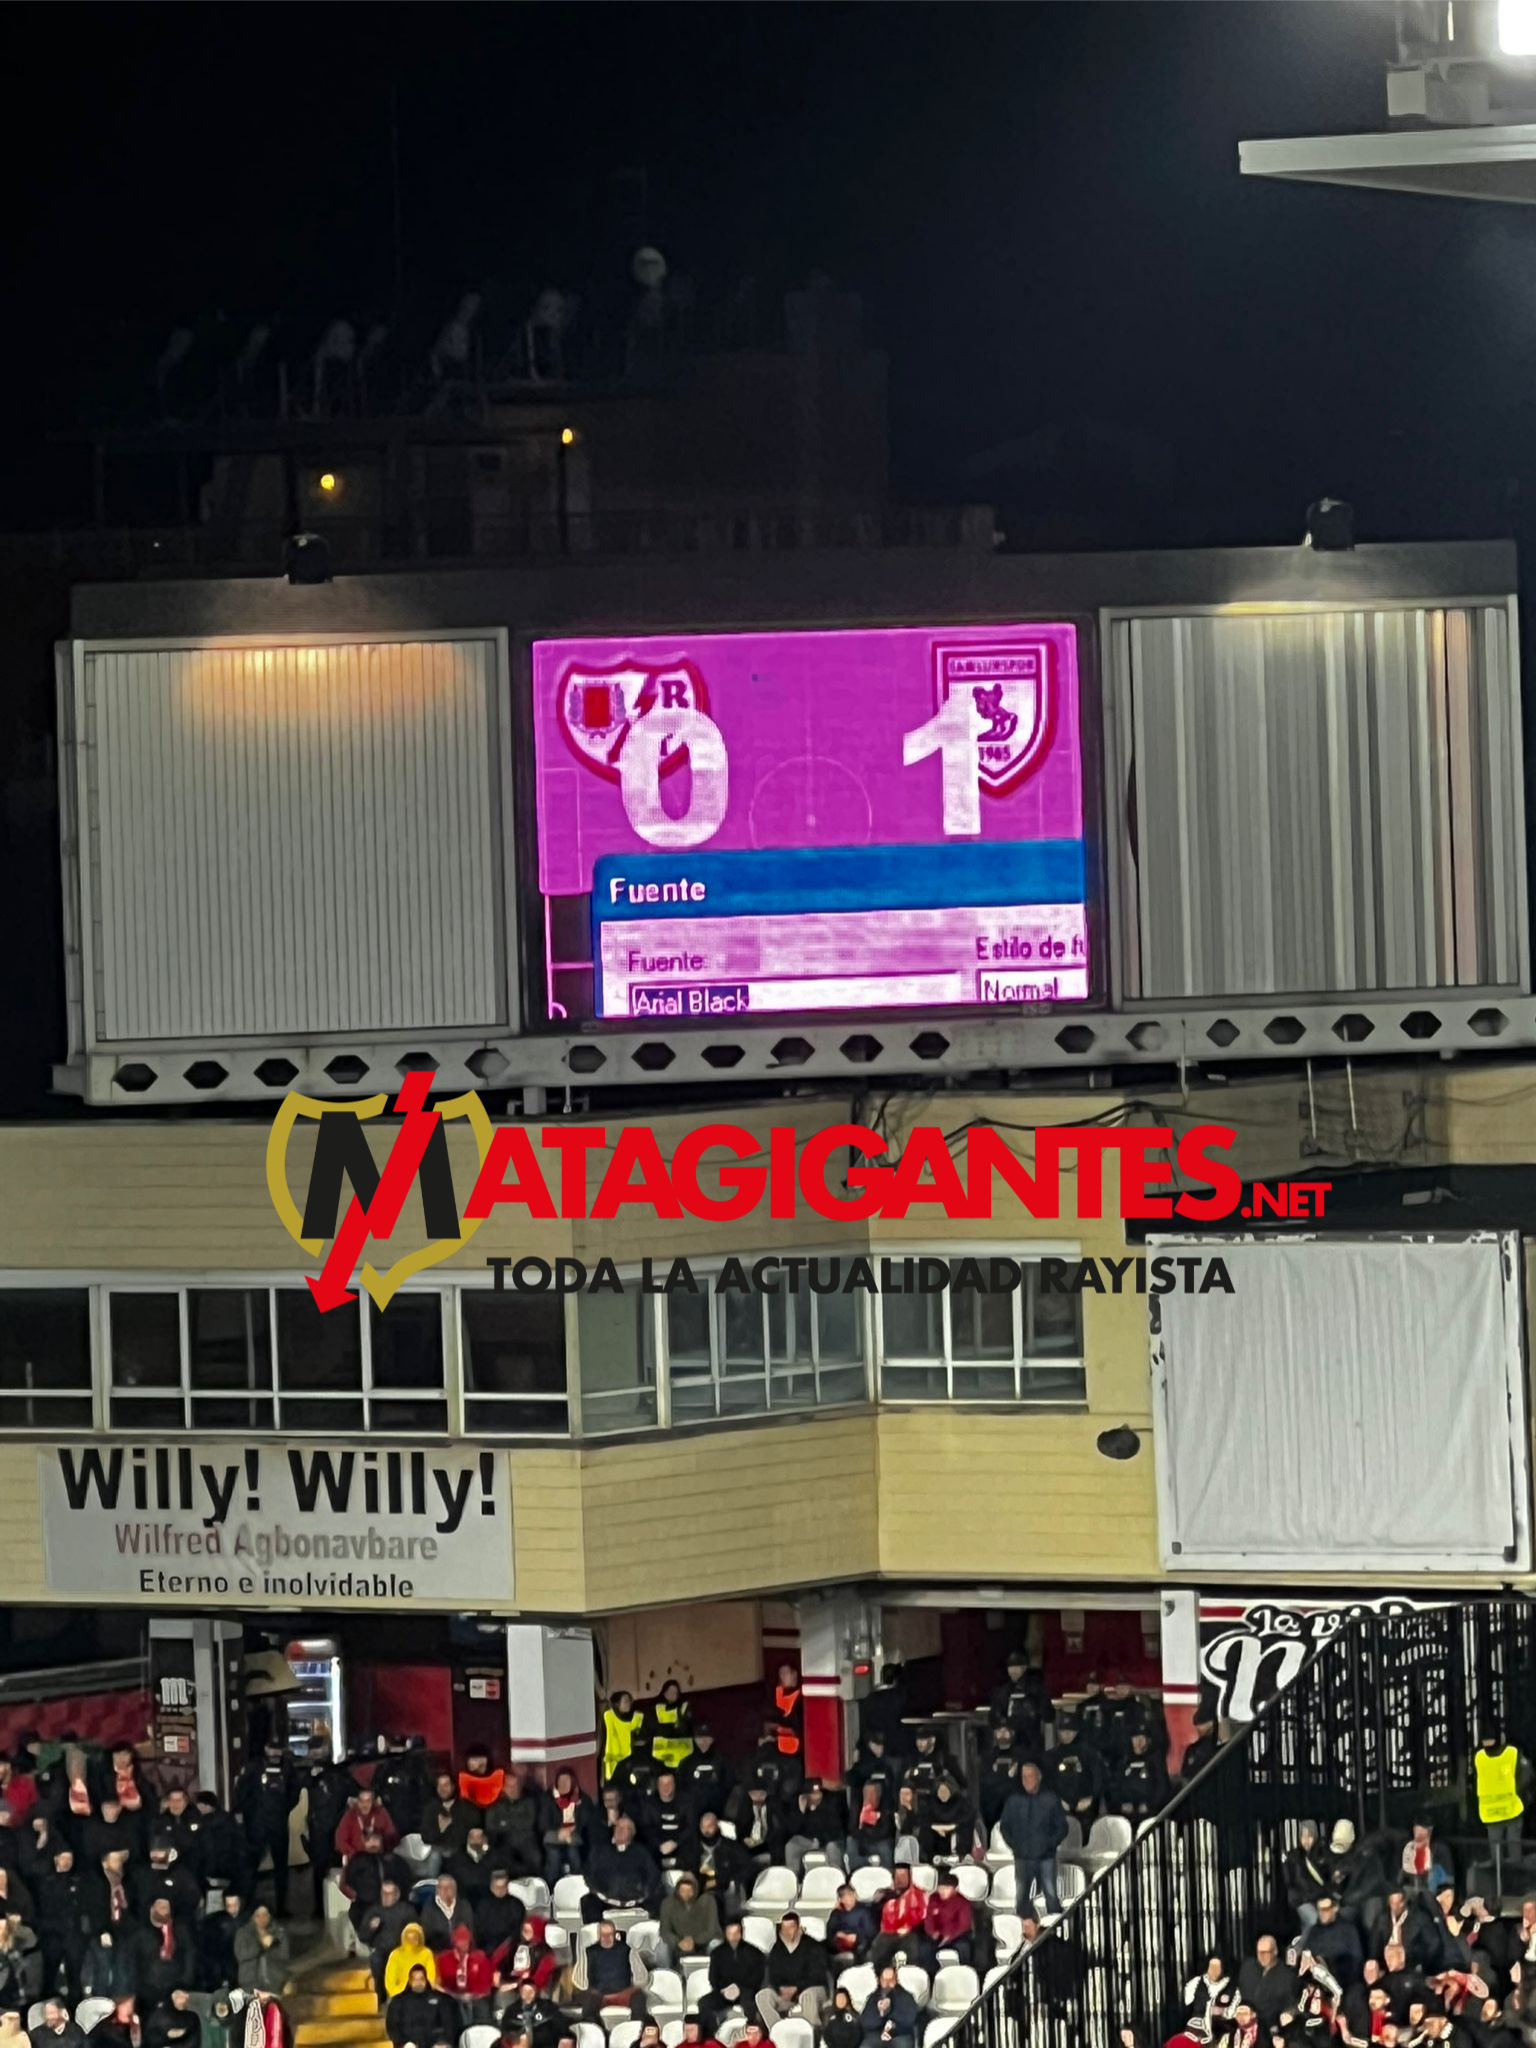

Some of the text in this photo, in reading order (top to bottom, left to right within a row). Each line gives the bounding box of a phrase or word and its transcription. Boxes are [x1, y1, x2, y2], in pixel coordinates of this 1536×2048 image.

[620, 693, 981, 847] 0 1
[610, 877, 706, 904] Fuente
[628, 950, 704, 973] Fuente
[975, 935, 1032, 960] Estilo
[1039, 935, 1066, 959] de
[635, 988, 749, 1016] Arial Black
[984, 976, 1059, 1001] Normal
[57, 1448, 496, 1533] Willy! Willy!
[115, 1523, 438, 1566] Wilfred Agbonavbare
[139, 1569, 414, 1598] Eterno e inolvidable
